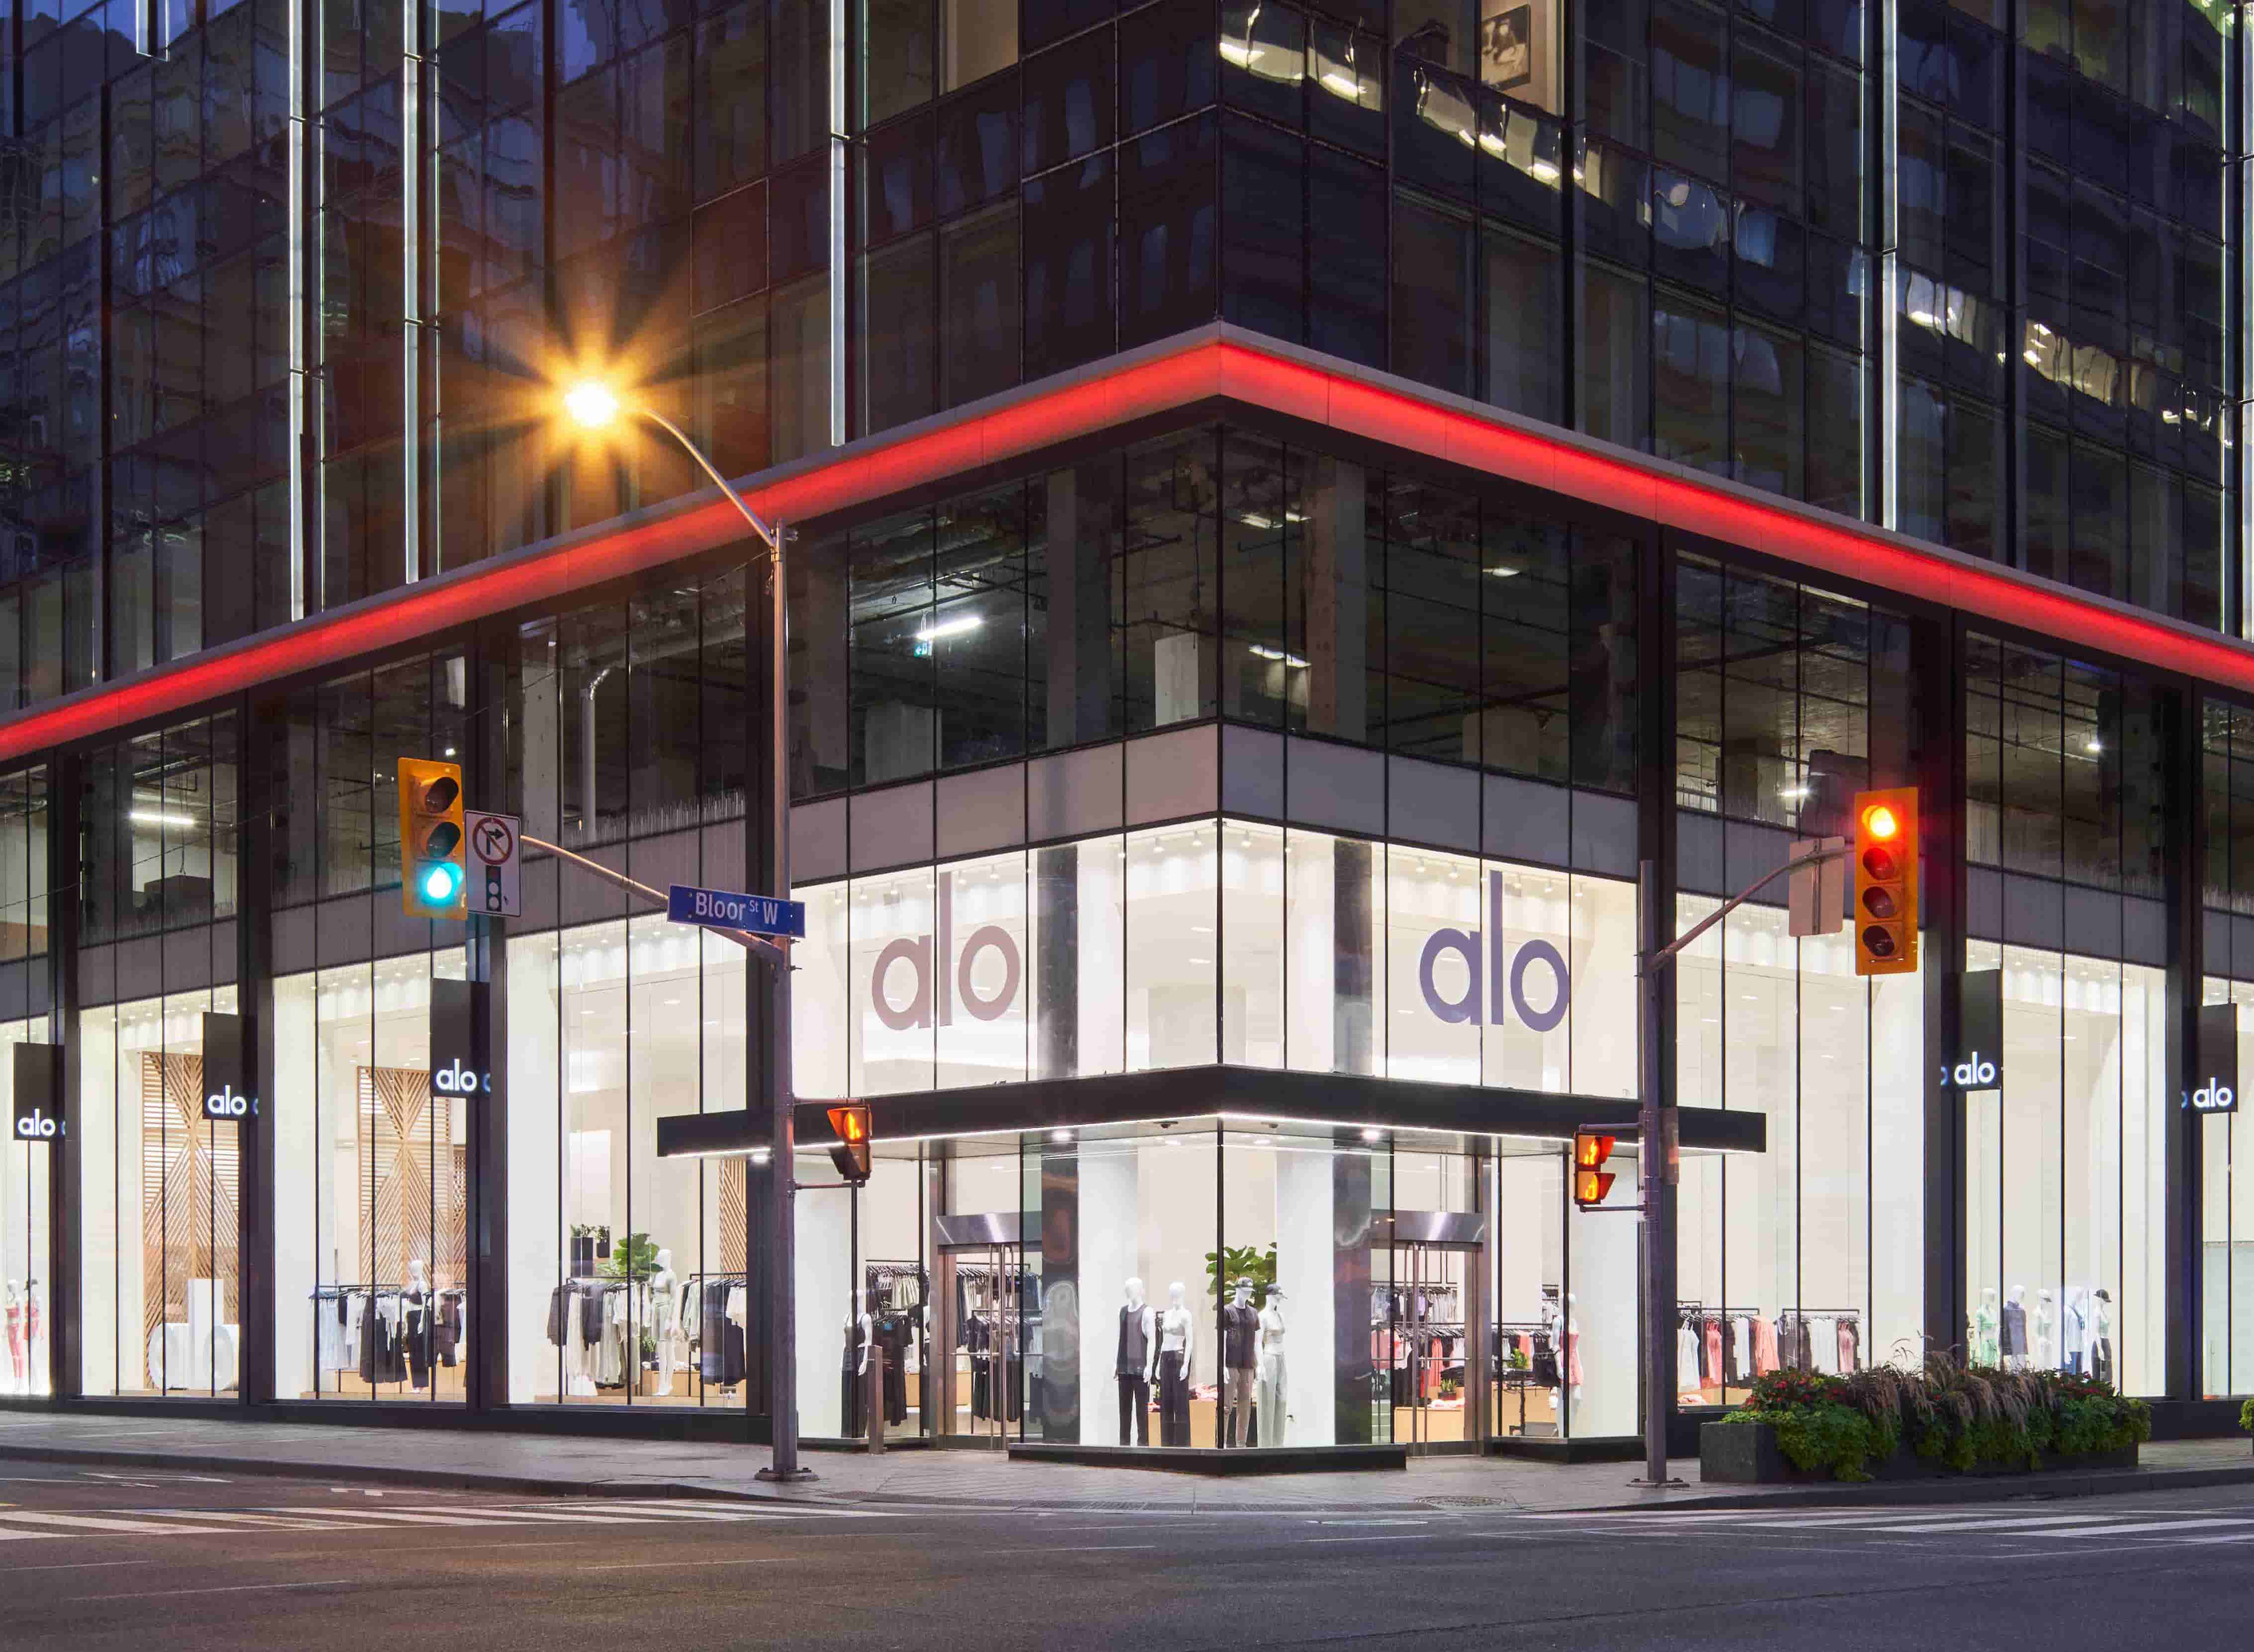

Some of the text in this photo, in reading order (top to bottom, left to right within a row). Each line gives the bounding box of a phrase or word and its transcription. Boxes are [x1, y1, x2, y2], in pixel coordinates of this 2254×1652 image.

[695, 891, 779, 925] Bloor St W
[871, 871, 1021, 1031] alo
[1419, 869, 1569, 1032] alo
[435, 1058, 477, 1091] alo
[1954, 1051, 1995, 1085] alo
[207, 1084, 247, 1115] alo
[2193, 1077, 2233, 1108] alo
[18, 1108, 56, 1136] alo
